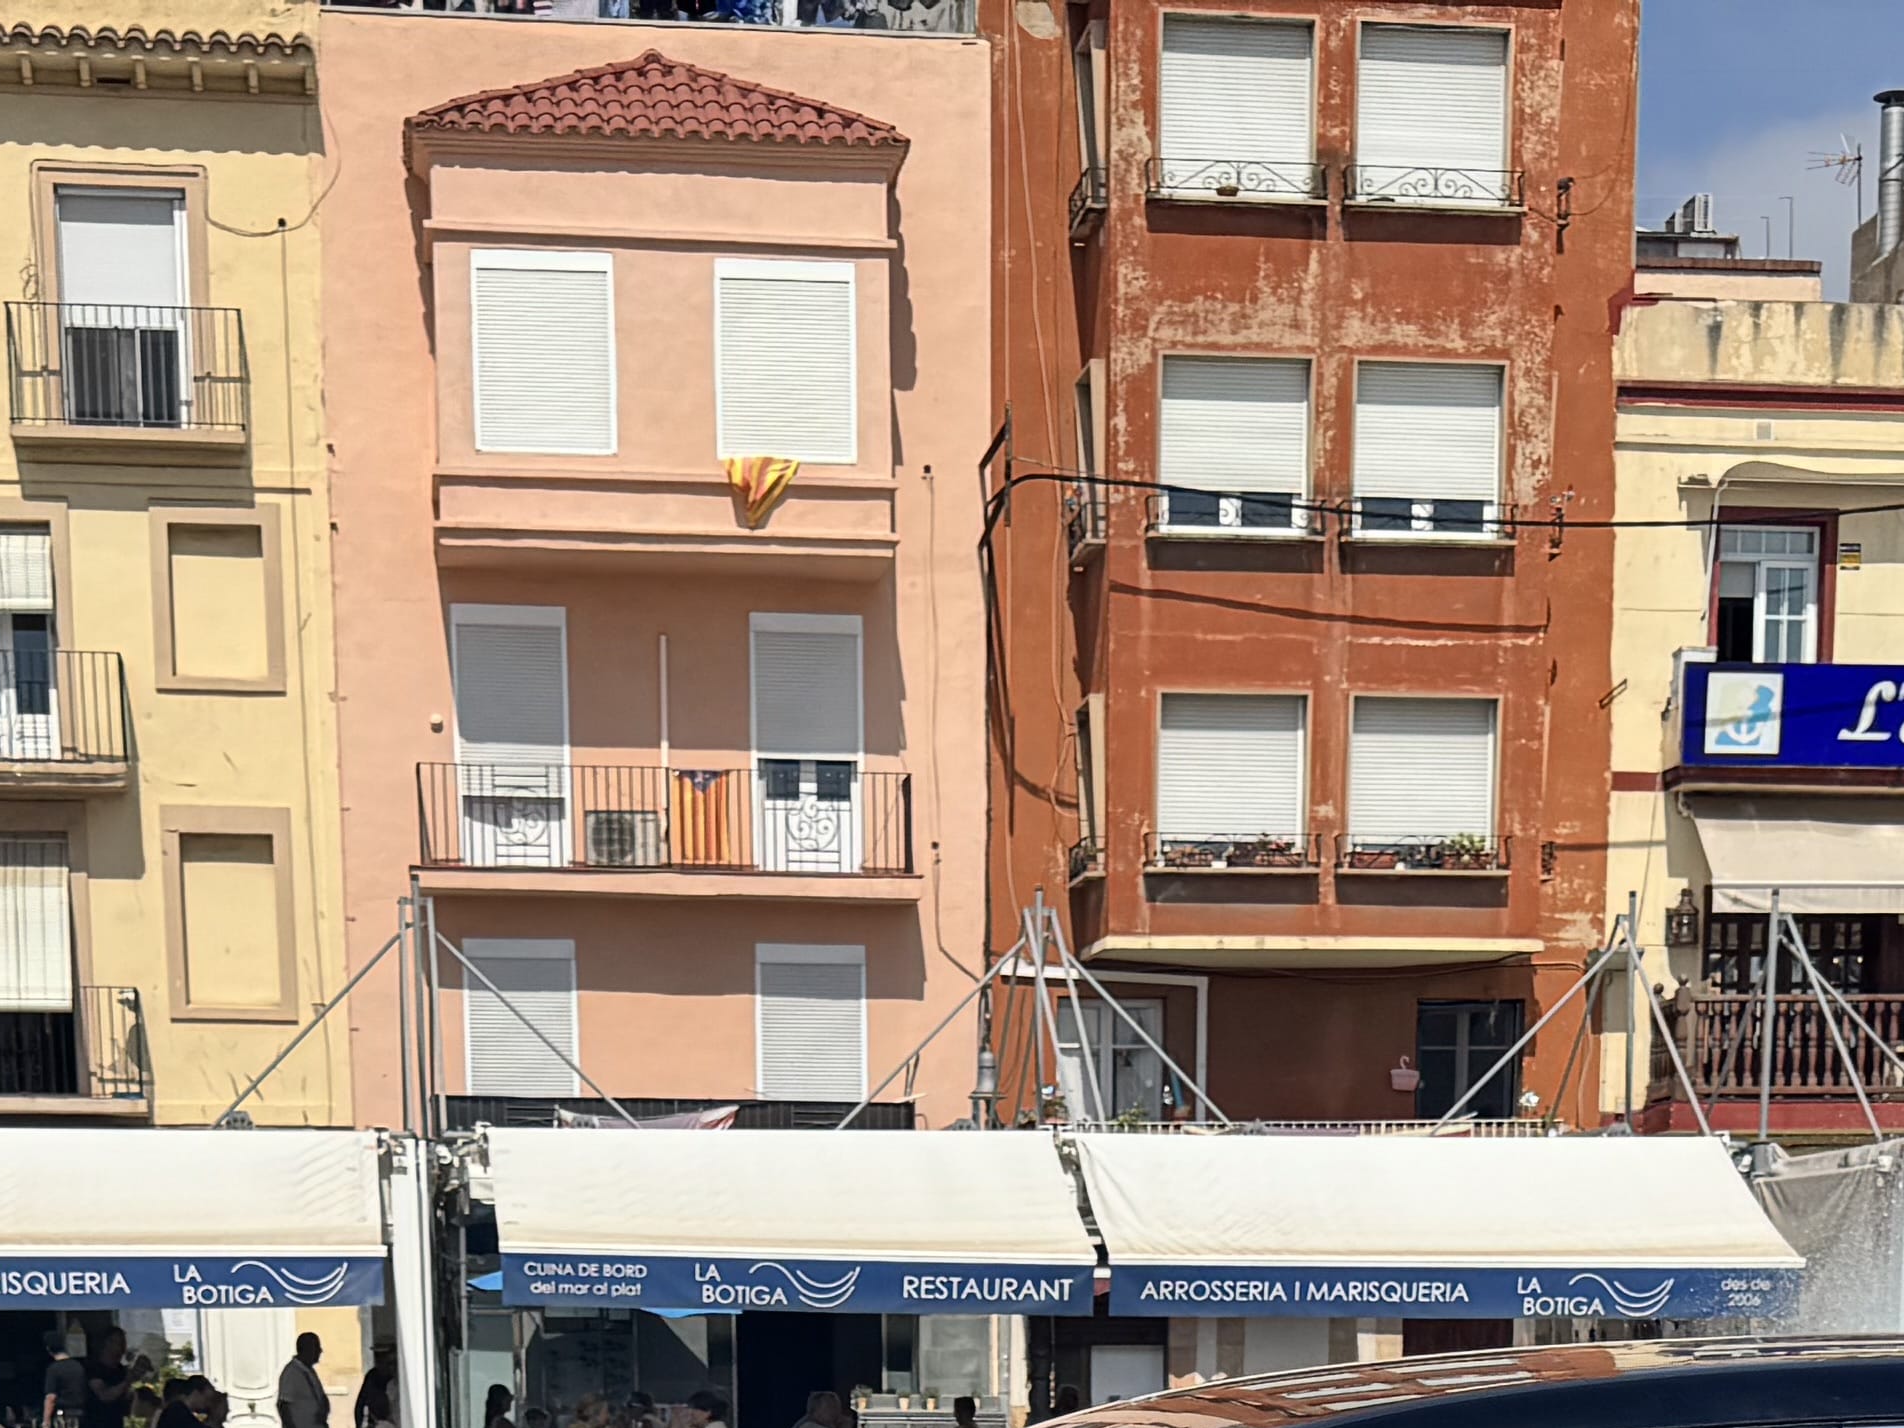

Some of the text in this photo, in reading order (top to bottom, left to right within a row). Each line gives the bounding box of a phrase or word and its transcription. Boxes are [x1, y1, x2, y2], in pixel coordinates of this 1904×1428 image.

[173, 1263, 201, 1283] LA
[523, 1261, 648, 1279] CUINA DE BORD
[694, 1263, 722, 1283] LA
[182, 1283, 274, 1306] BOTIGA
[529, 1280, 642, 1298] del mar al plat
[702, 1284, 788, 1306] BOTIGA
[902, 1274, 1073, 1303] RESTAURANT
[1140, 1278, 1288, 1303] ARROSSERIA
[1307, 1279, 1470, 1306] MARISQUERIA
[1516, 1277, 1543, 1295] LA
[1523, 1295, 1606, 1317] BOTIGA
